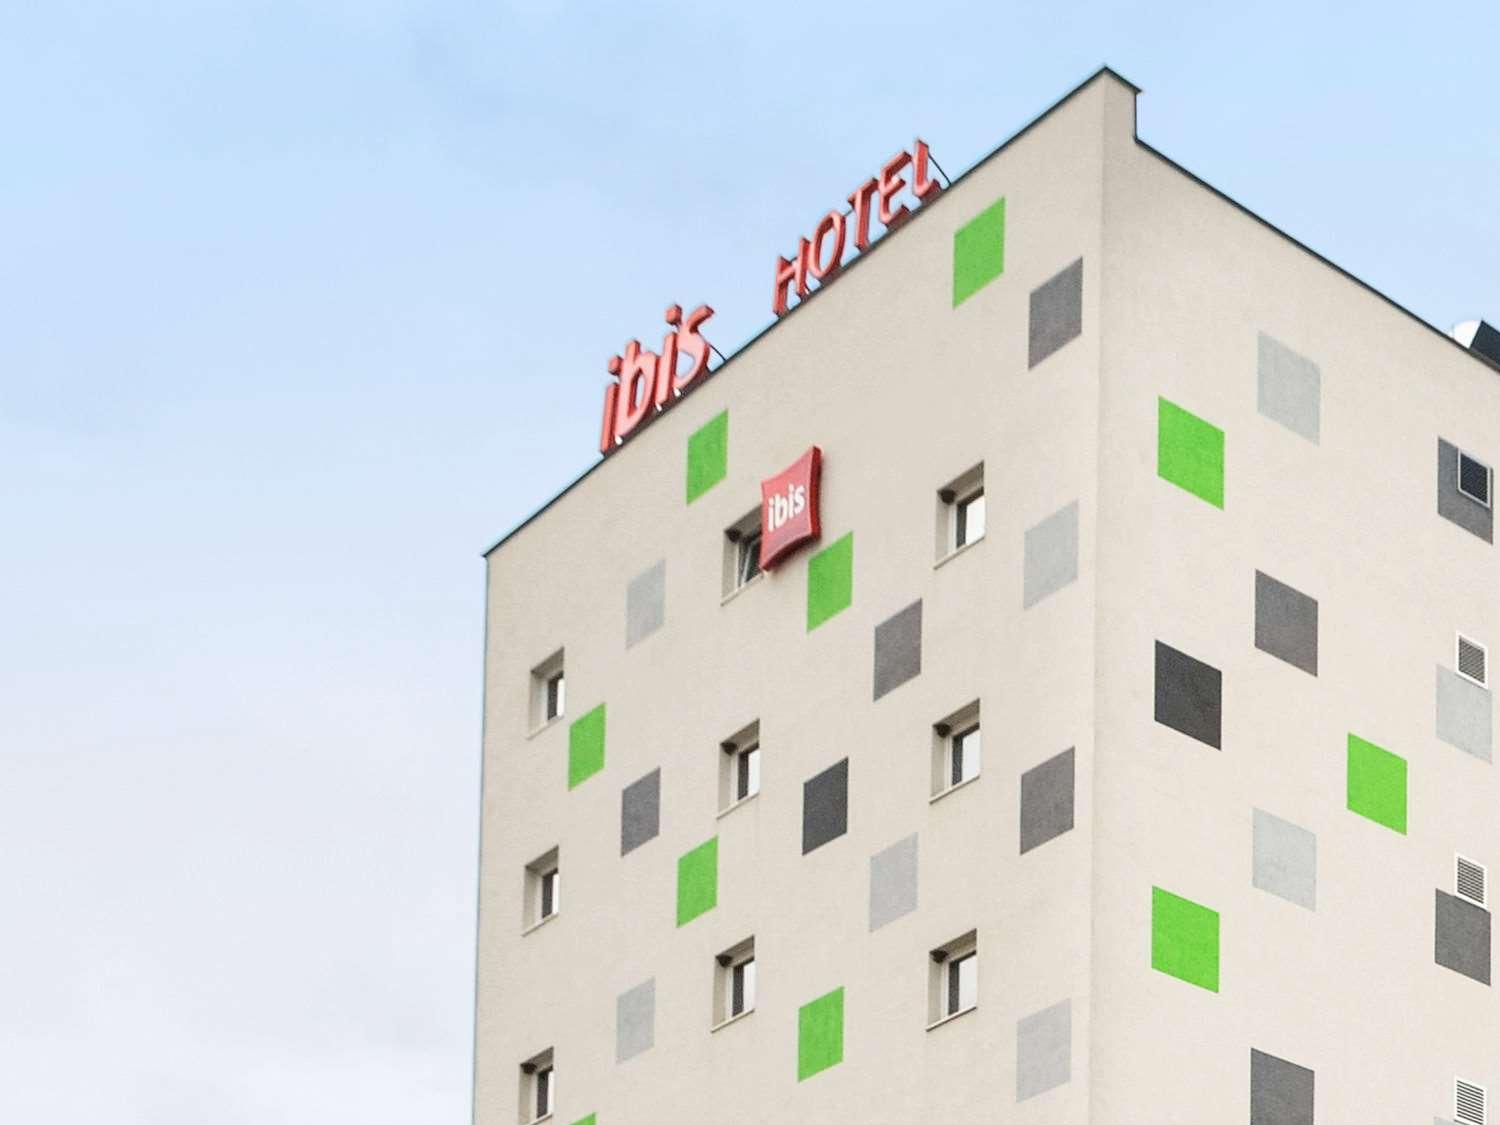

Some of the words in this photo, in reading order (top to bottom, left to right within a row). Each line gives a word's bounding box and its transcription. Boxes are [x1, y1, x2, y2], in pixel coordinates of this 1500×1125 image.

[600, 304, 714, 453] ibis
[773, 139, 942, 317] HOTEL
[768, 483, 806, 533] ibis
